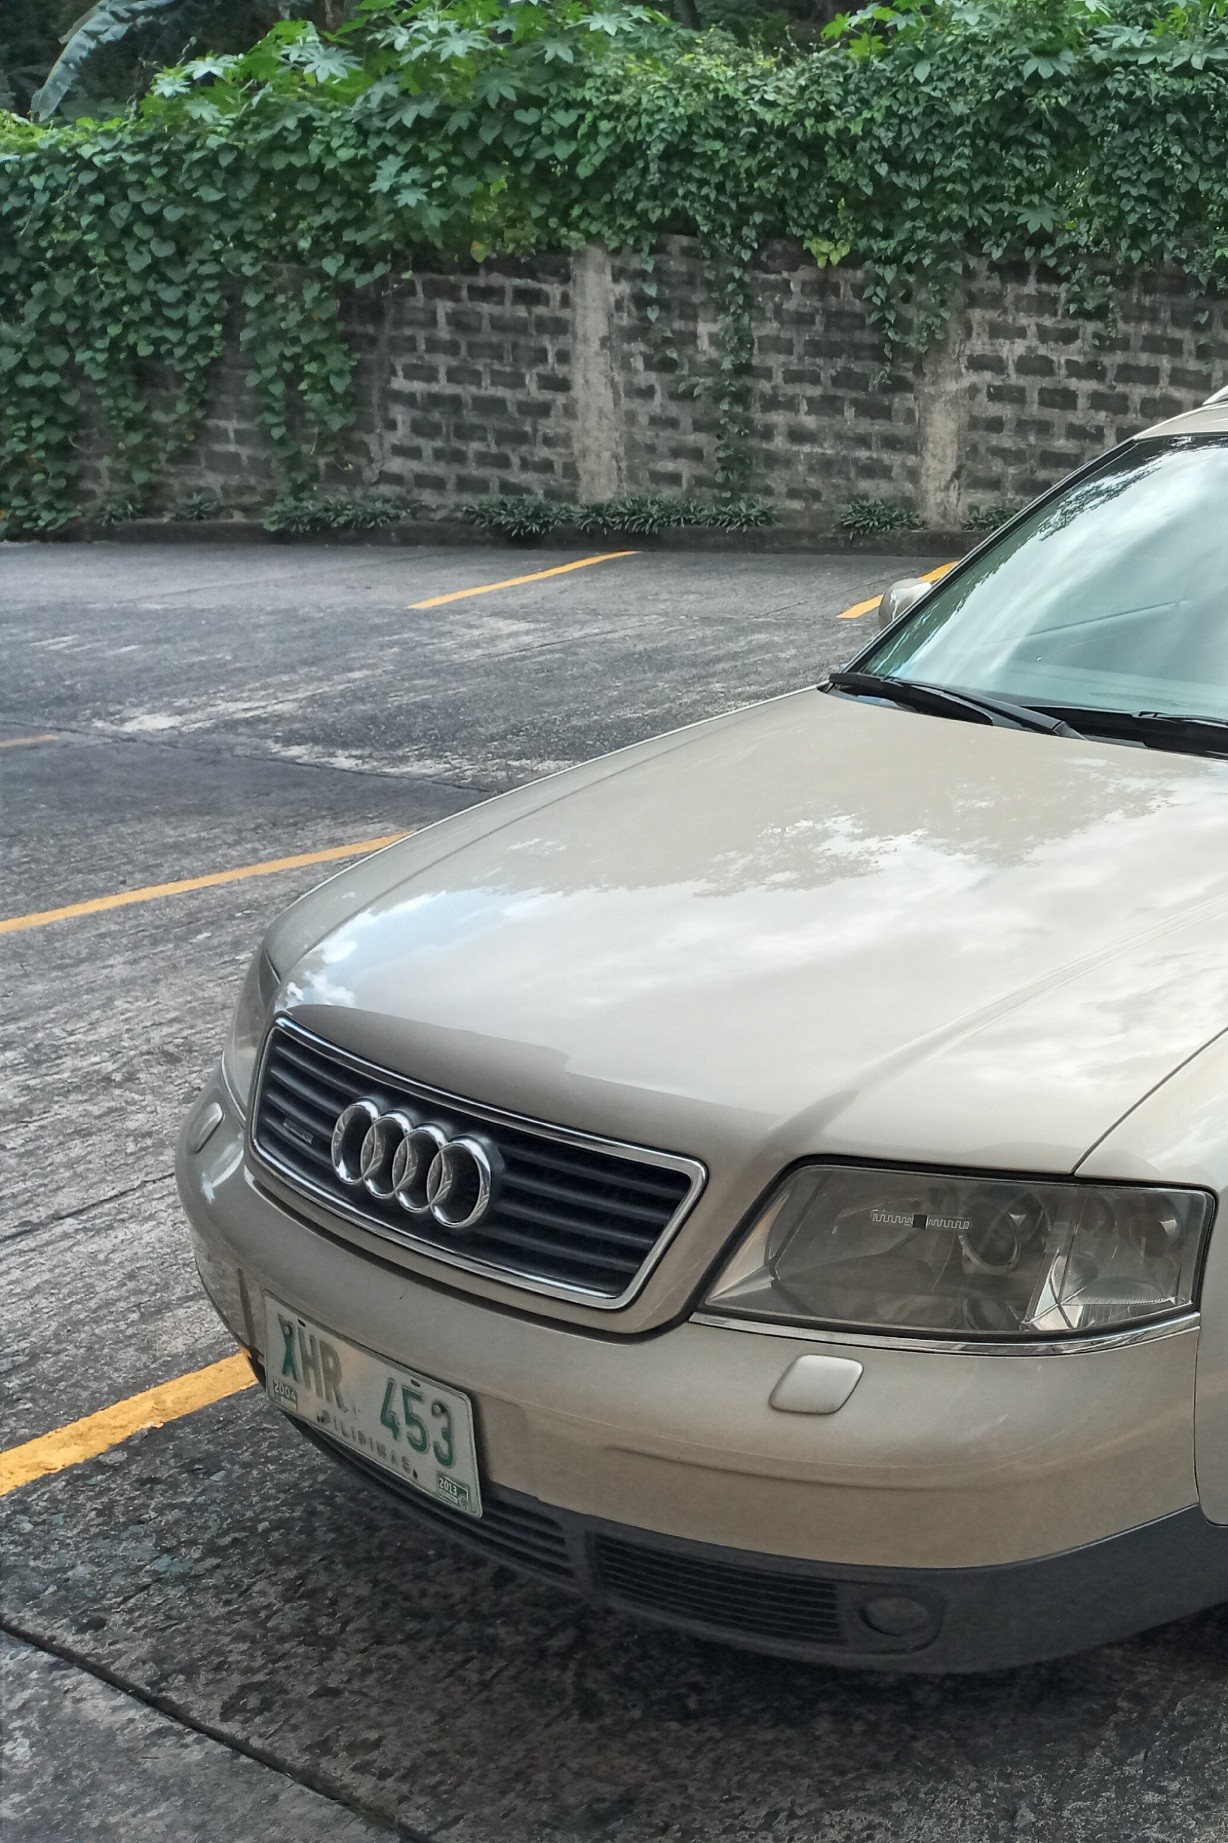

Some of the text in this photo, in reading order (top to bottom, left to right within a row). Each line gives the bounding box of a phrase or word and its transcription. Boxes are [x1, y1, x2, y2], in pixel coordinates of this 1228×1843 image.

[278, 1314, 455, 1468] XHR 453
[439, 1477, 458, 1496] 2013
